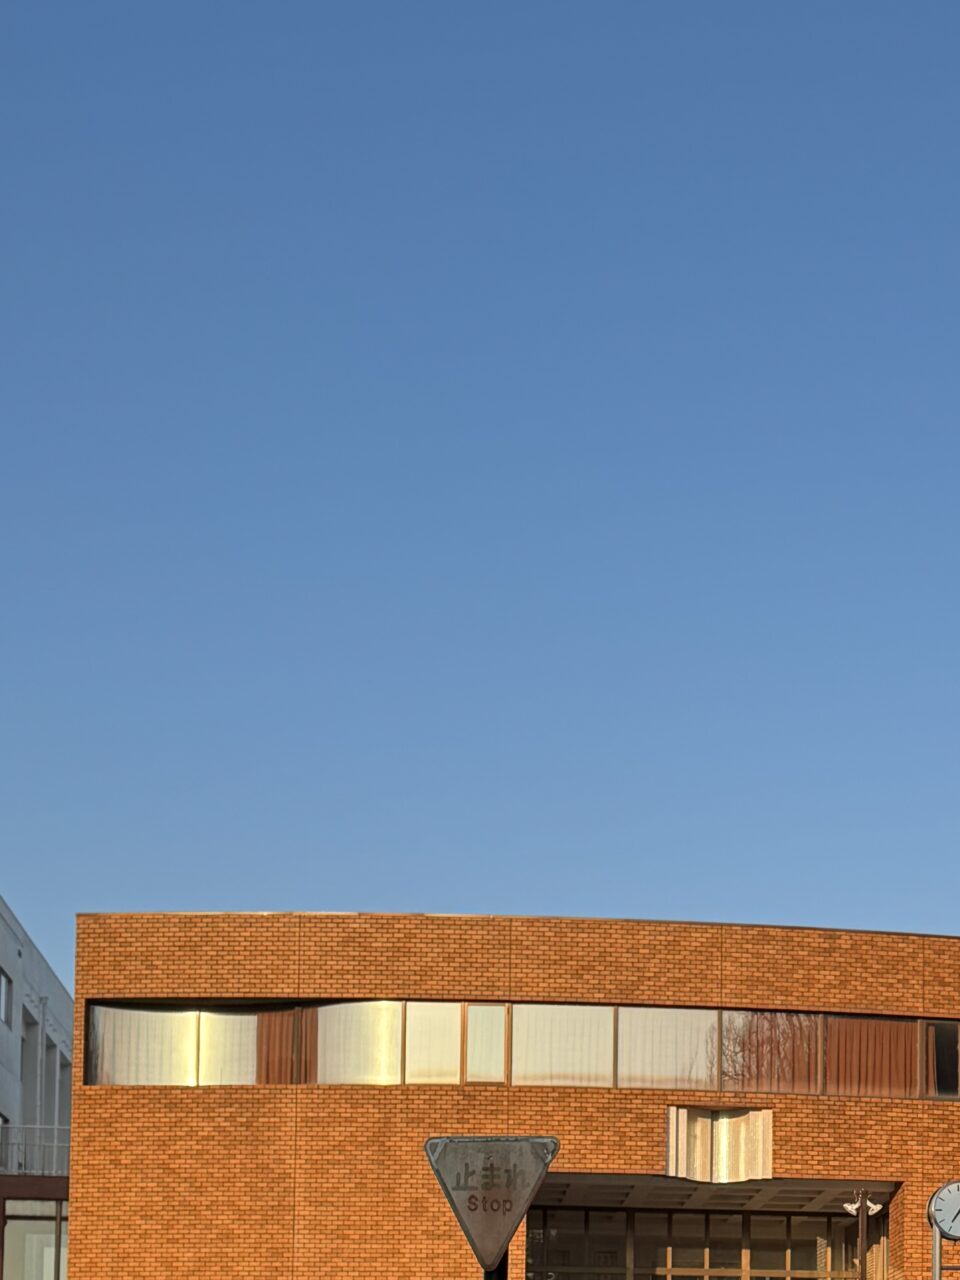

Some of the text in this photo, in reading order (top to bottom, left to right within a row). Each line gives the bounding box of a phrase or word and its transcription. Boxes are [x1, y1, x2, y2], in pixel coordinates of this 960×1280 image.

[451, 1162, 530, 1192] 止まれ
[467, 1194, 513, 1215] Stop
